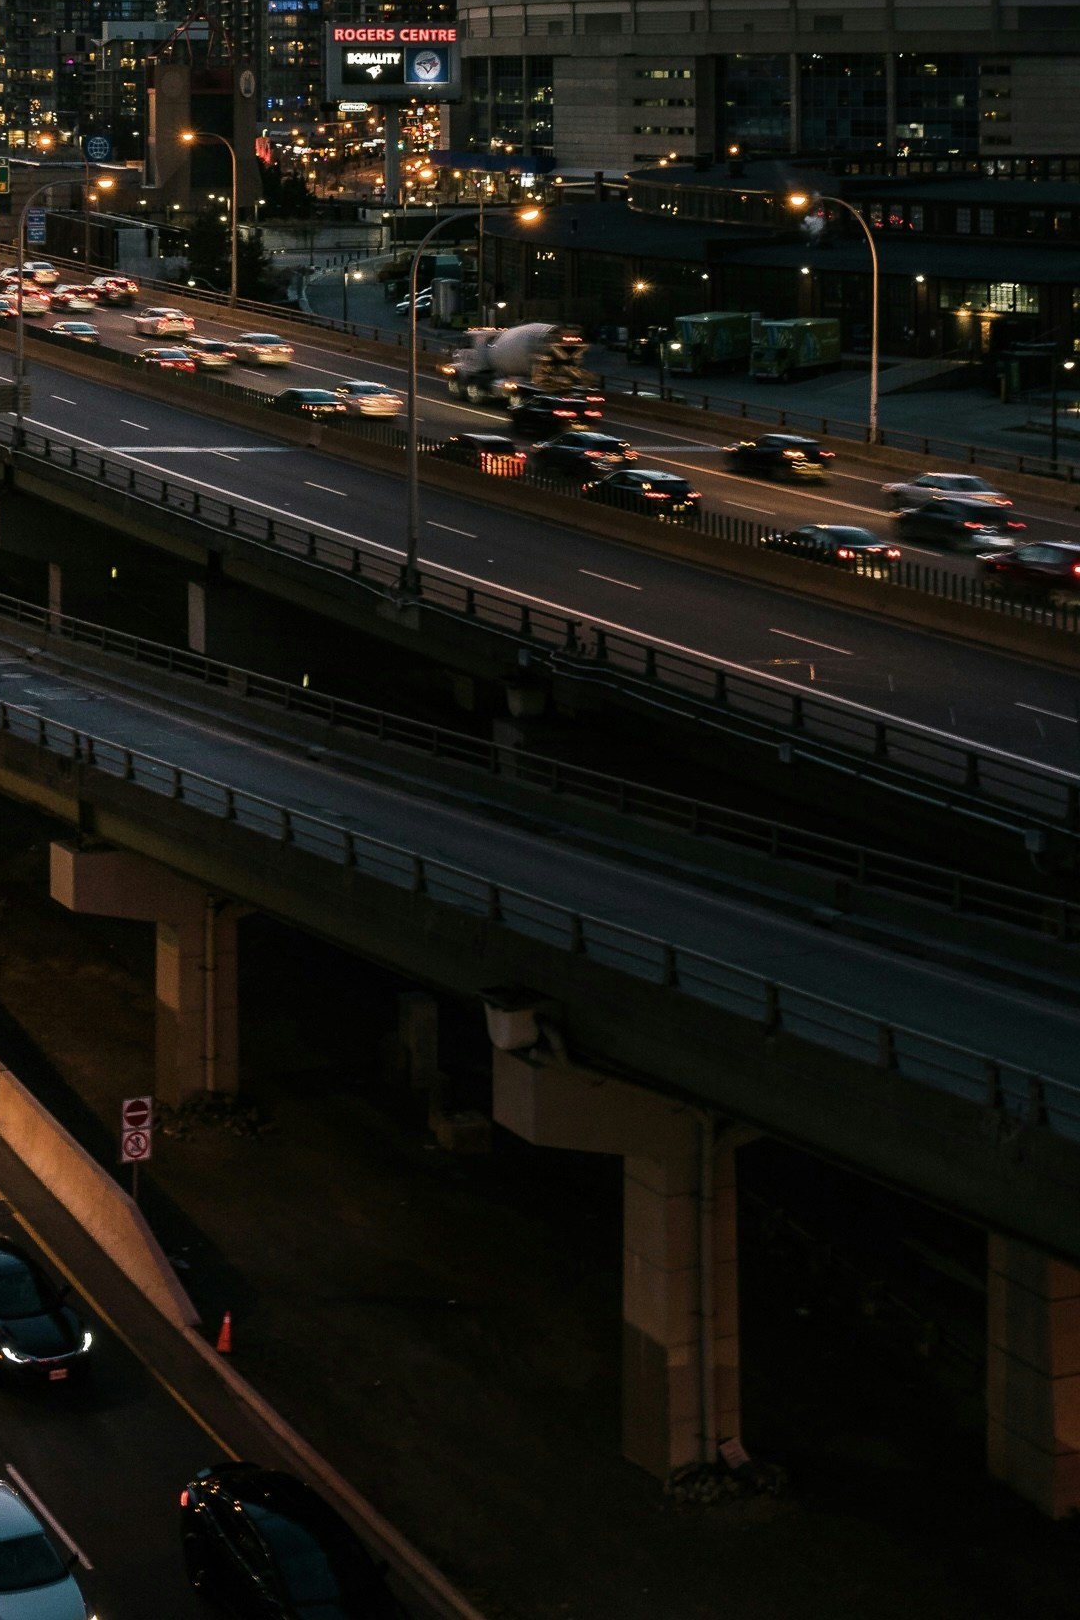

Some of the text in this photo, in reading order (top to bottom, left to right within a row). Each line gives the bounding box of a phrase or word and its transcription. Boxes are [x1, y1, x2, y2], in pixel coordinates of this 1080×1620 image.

[334, 28, 457, 42] ROGERS CENTRE
[346, 52, 401, 65] EQUALITY
